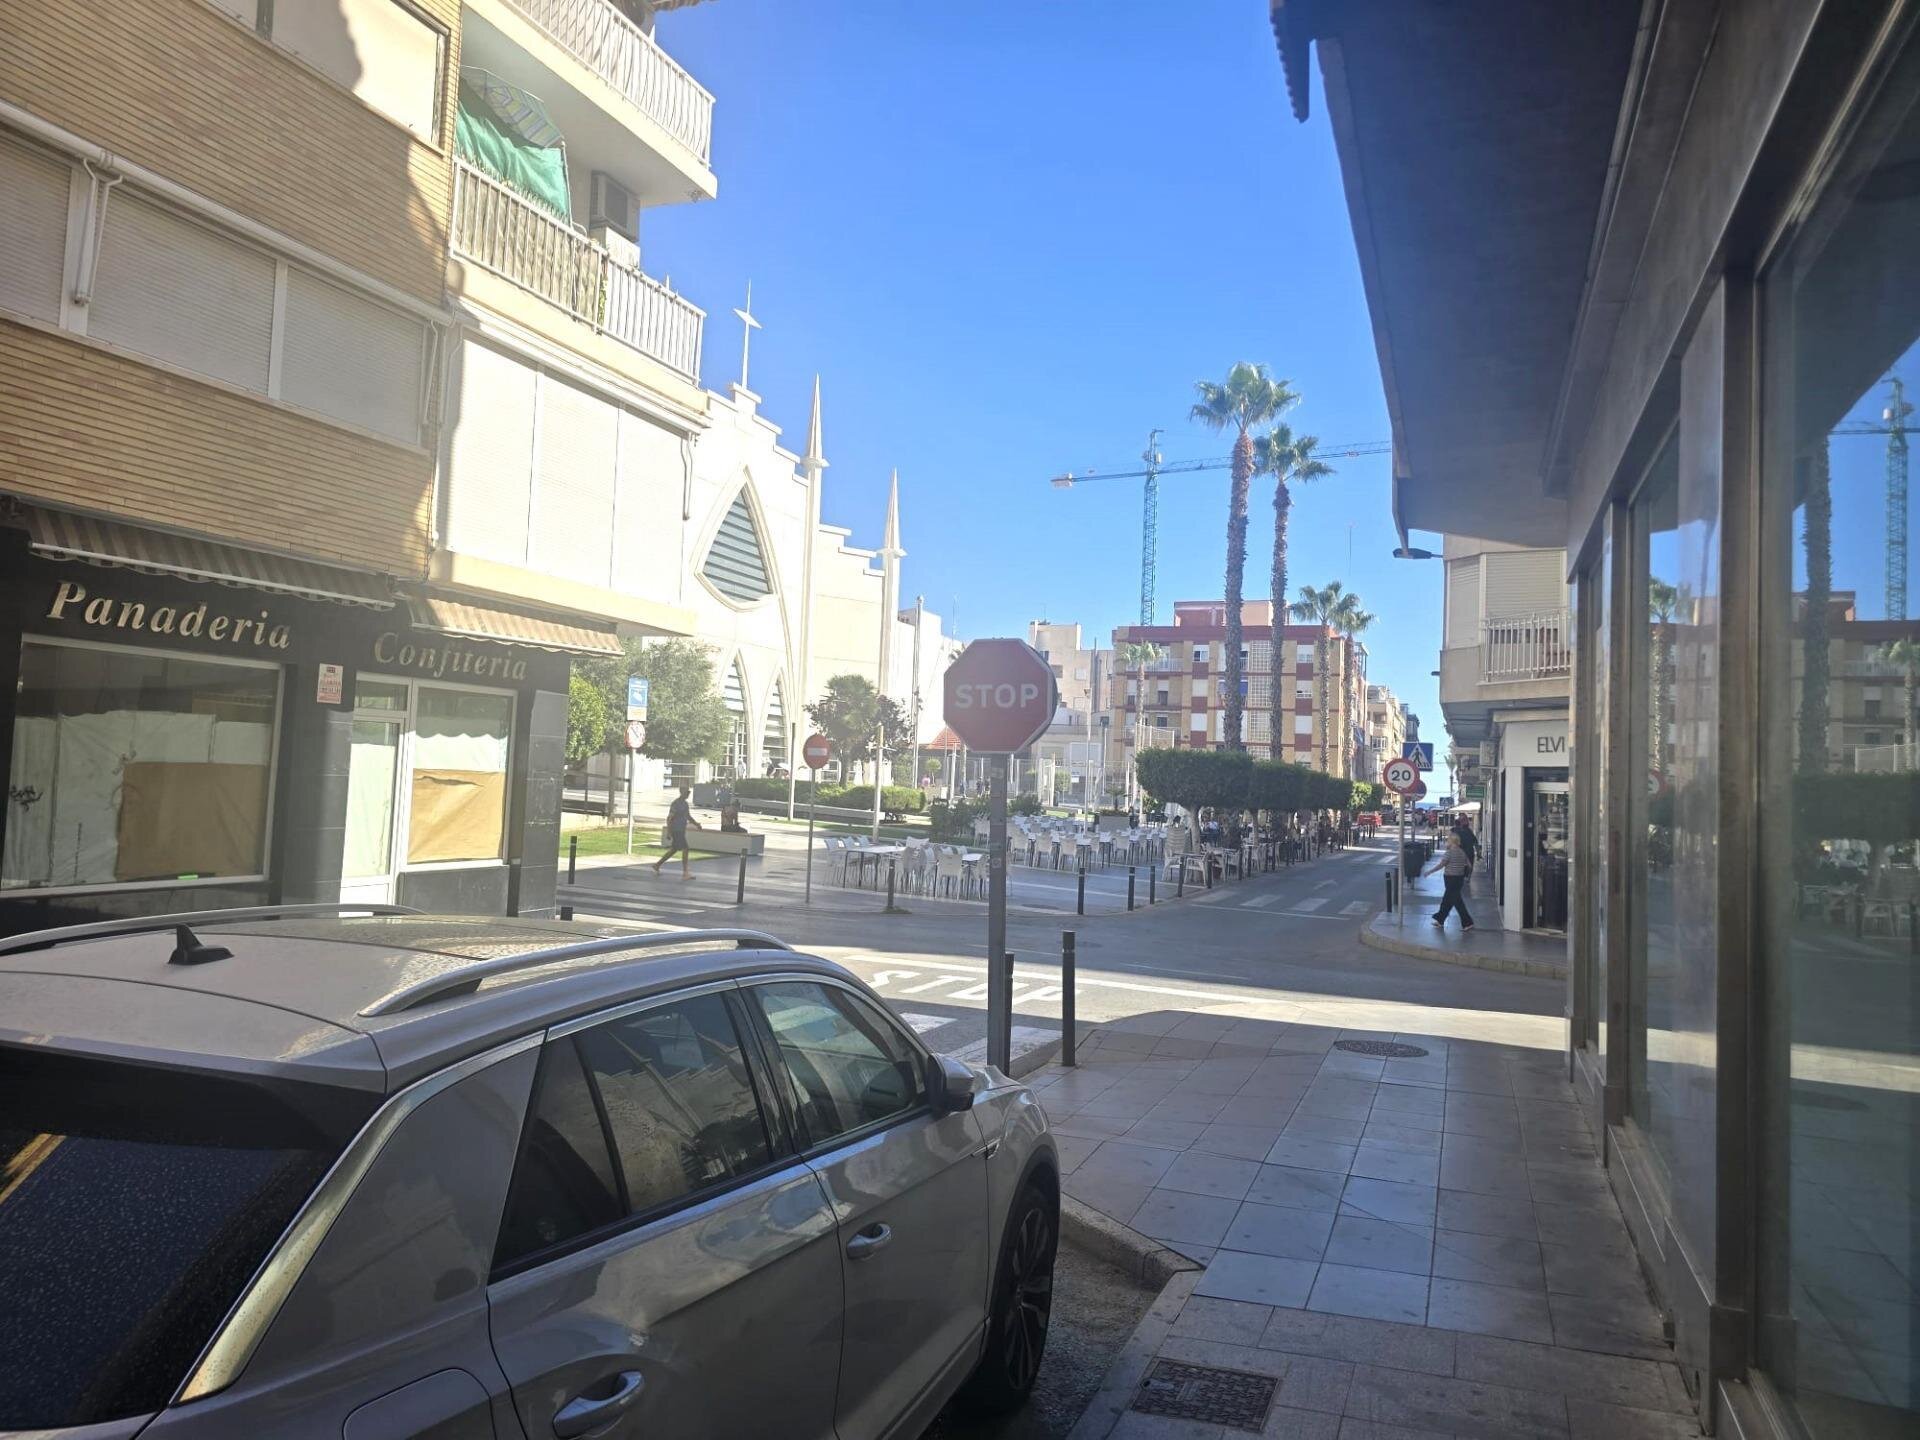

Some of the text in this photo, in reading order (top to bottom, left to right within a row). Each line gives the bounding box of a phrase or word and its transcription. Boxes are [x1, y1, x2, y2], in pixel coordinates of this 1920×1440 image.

[46, 580, 290, 649] Panaderia
[374, 631, 528, 680] Confiteria
[955, 683, 1039, 708] STOP
[1537, 736, 1565, 753] ELVI
[1391, 769, 1411, 781] 20
[866, 970, 1082, 1006] STOP
